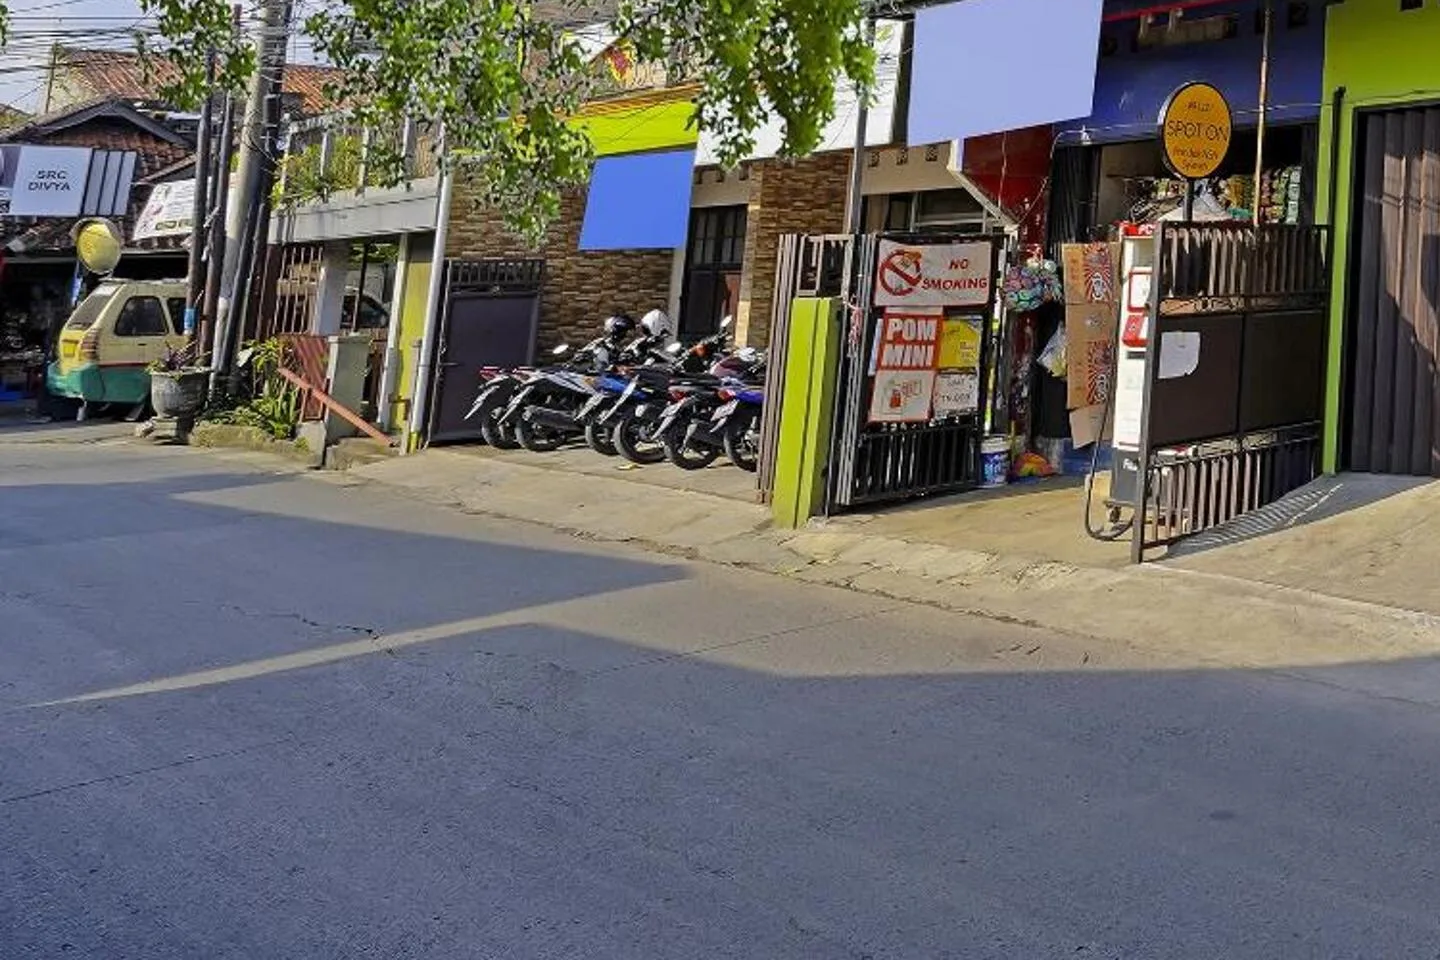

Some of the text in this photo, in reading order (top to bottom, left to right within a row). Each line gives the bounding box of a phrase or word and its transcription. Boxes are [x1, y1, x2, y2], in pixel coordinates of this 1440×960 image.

[1167, 120, 1228, 141] SPOT ON
[36, 169, 68, 181] SRC
[28, 181, 71, 191] DIVYA
[948, 258, 969, 270] NO
[921, 278, 988, 291] SMOKING
[886, 318, 938, 341] POM
[881, 343, 935, 368] MINI
